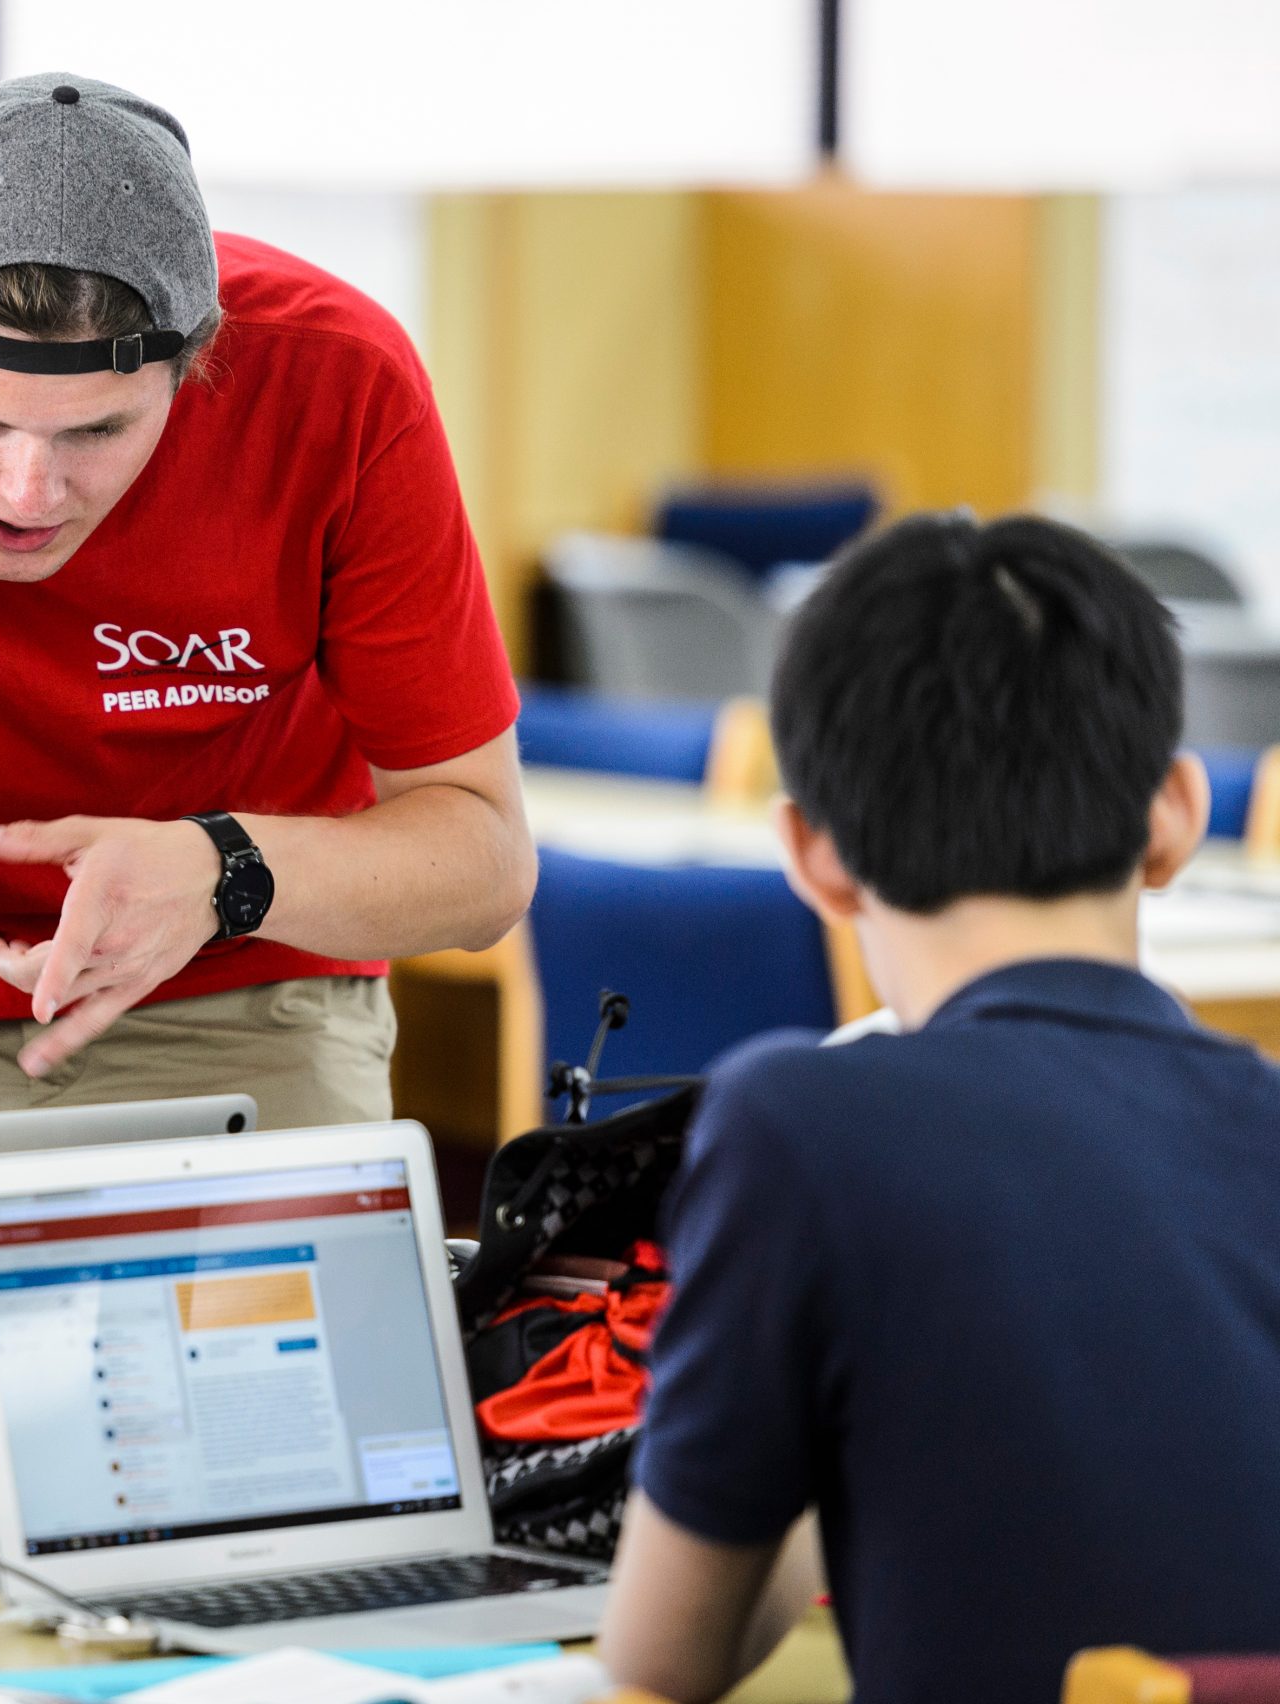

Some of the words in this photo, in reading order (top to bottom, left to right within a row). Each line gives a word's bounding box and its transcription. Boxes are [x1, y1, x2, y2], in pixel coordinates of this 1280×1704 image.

[93, 622, 266, 672] SOAR
[103, 688, 161, 713] PEER
[165, 684, 270, 708] ADVISOR
